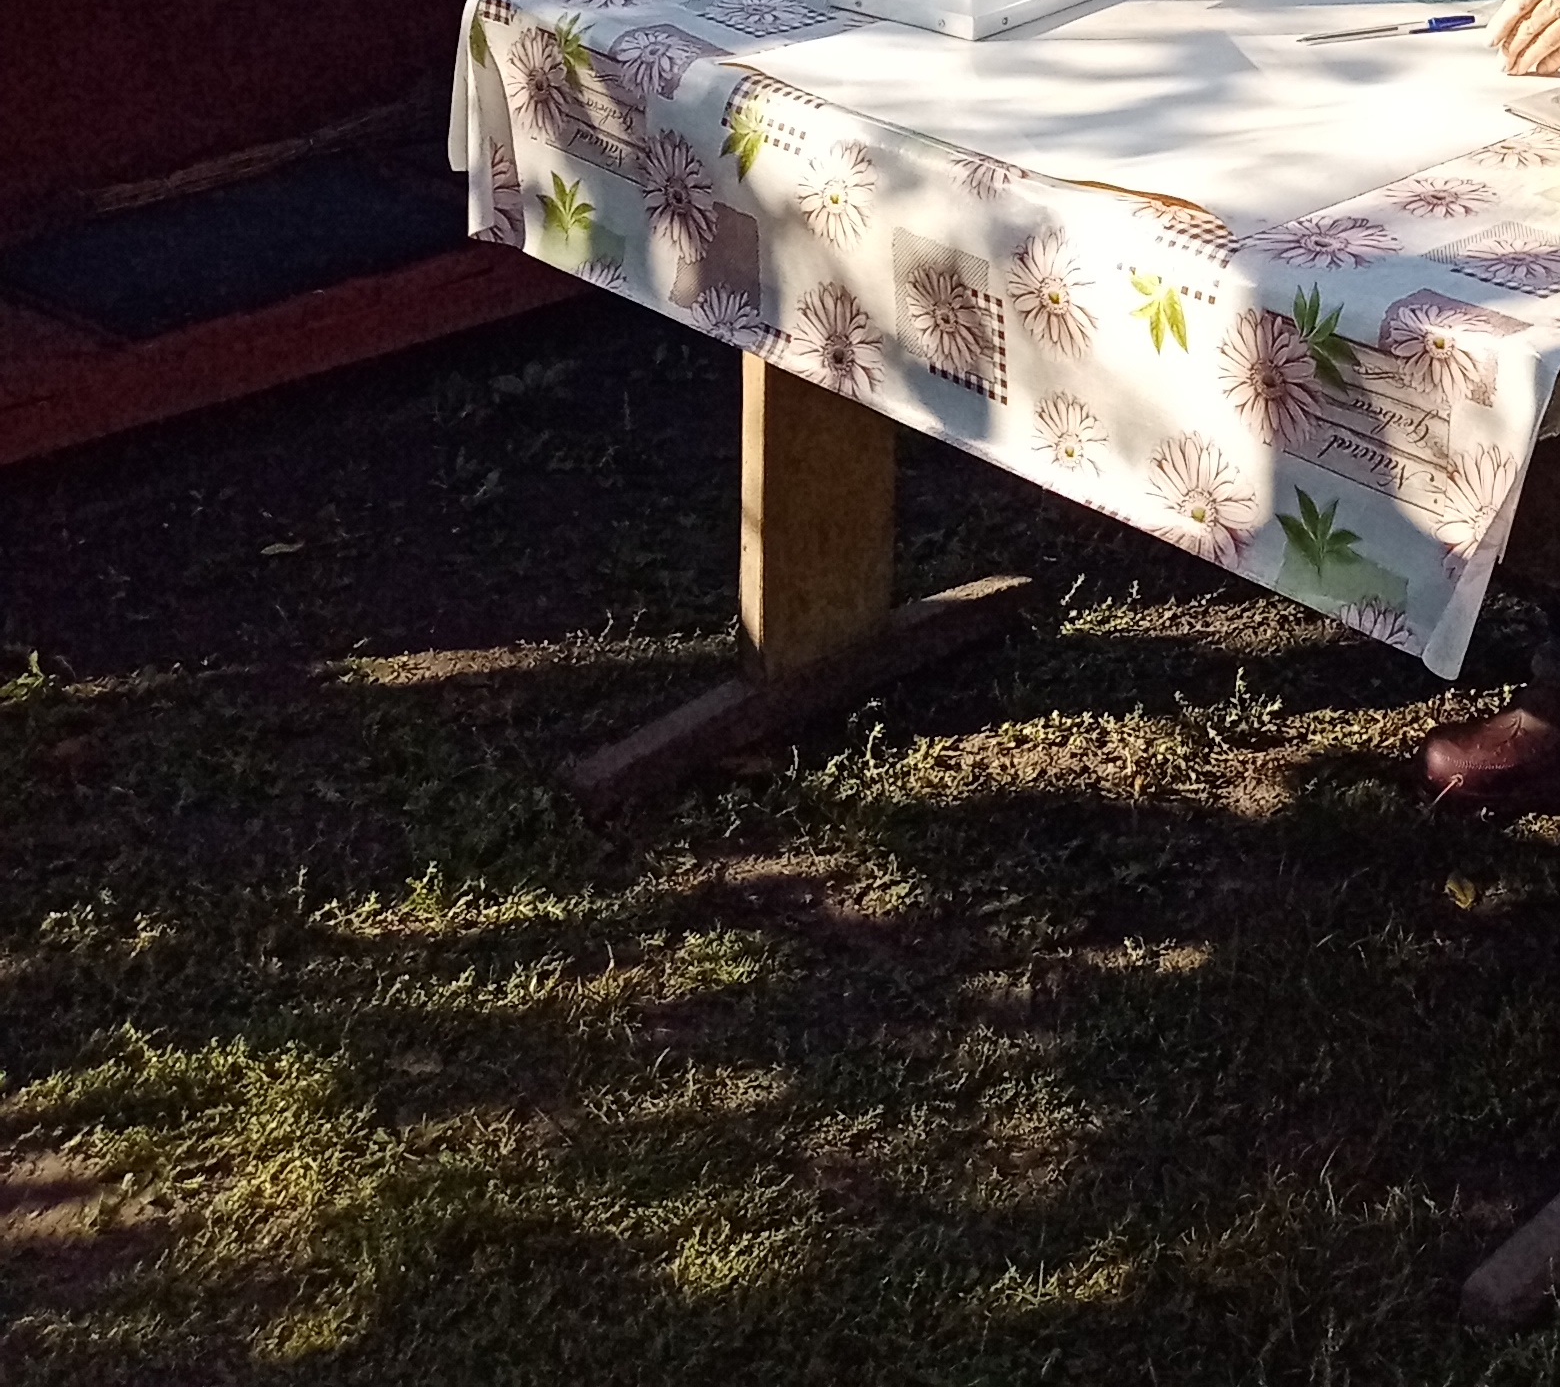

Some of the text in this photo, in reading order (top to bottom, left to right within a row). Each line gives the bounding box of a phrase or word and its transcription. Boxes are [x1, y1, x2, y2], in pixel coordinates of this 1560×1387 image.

[586, 98, 635, 132] Gerbera
[567, 127, 640, 168] Natural
[1351, 397, 1439, 448] Gerbera
[1317, 434, 1435, 490] Natural
